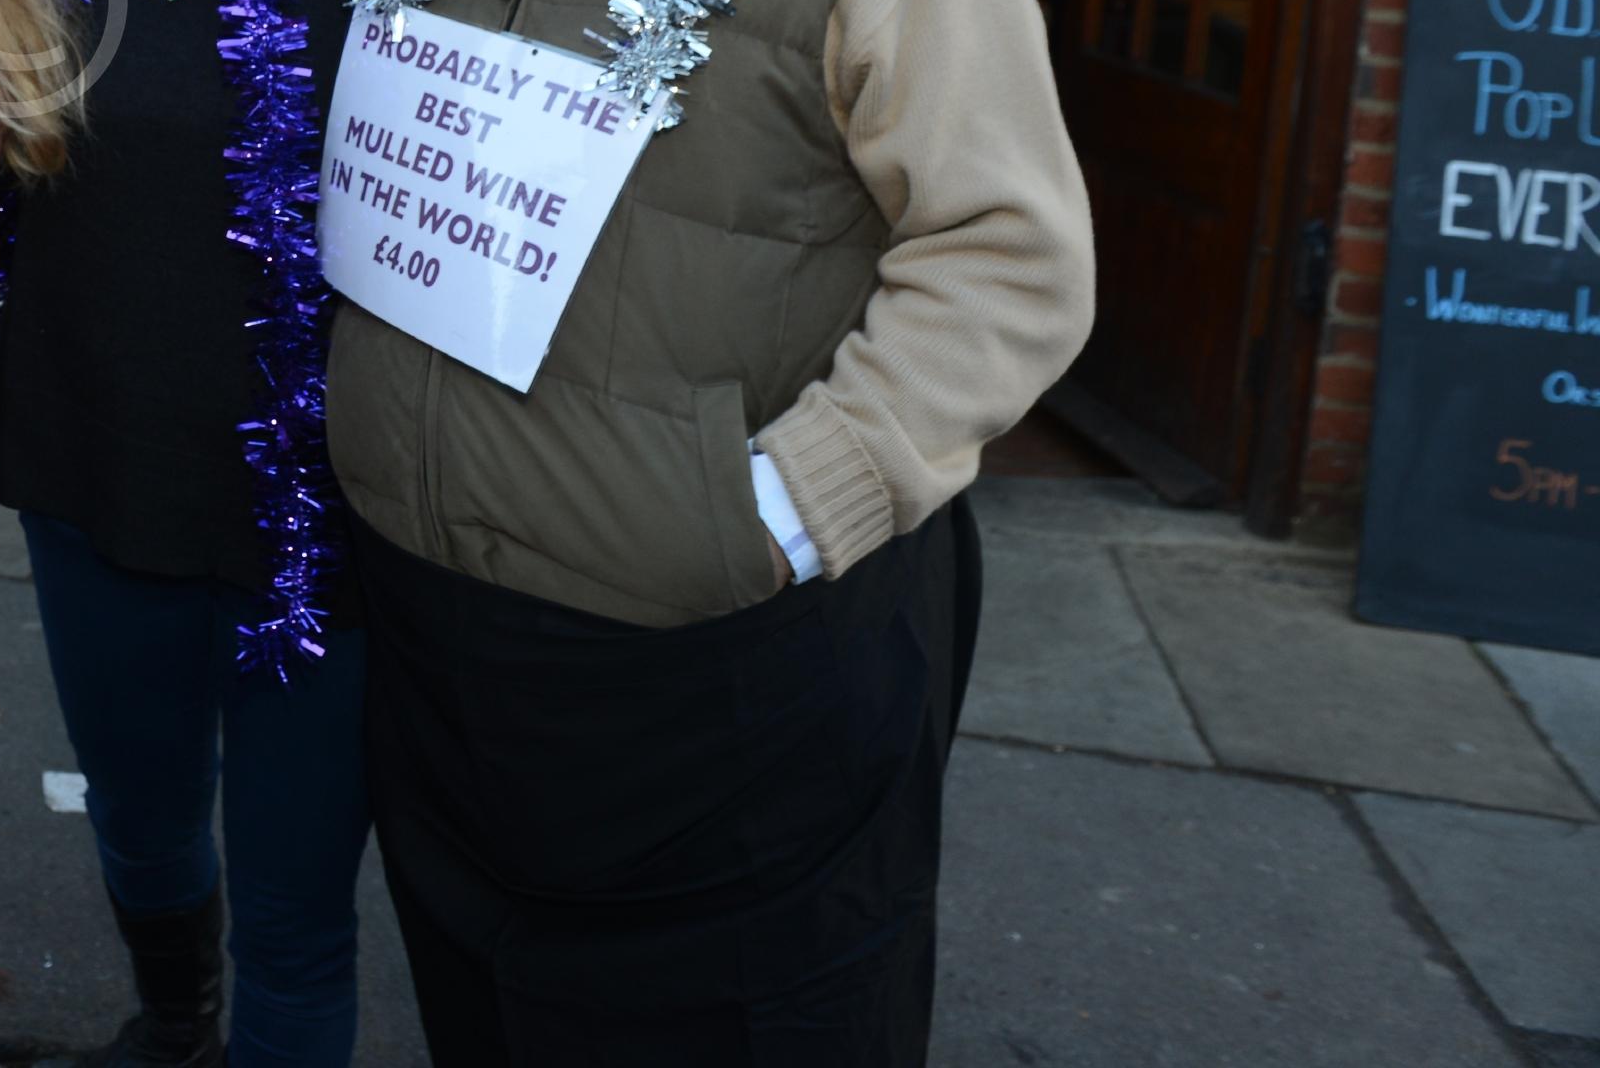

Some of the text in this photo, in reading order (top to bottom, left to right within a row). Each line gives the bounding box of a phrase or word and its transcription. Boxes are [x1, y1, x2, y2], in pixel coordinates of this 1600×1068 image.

[362, 23, 626, 135] PROBABLY THE
[415, 92, 502, 143] BEST
[330, 158, 557, 282] IN THE WORLD!
[345, 116, 567, 227] MULLED WINE
[373, 235, 440, 287] £4.00
